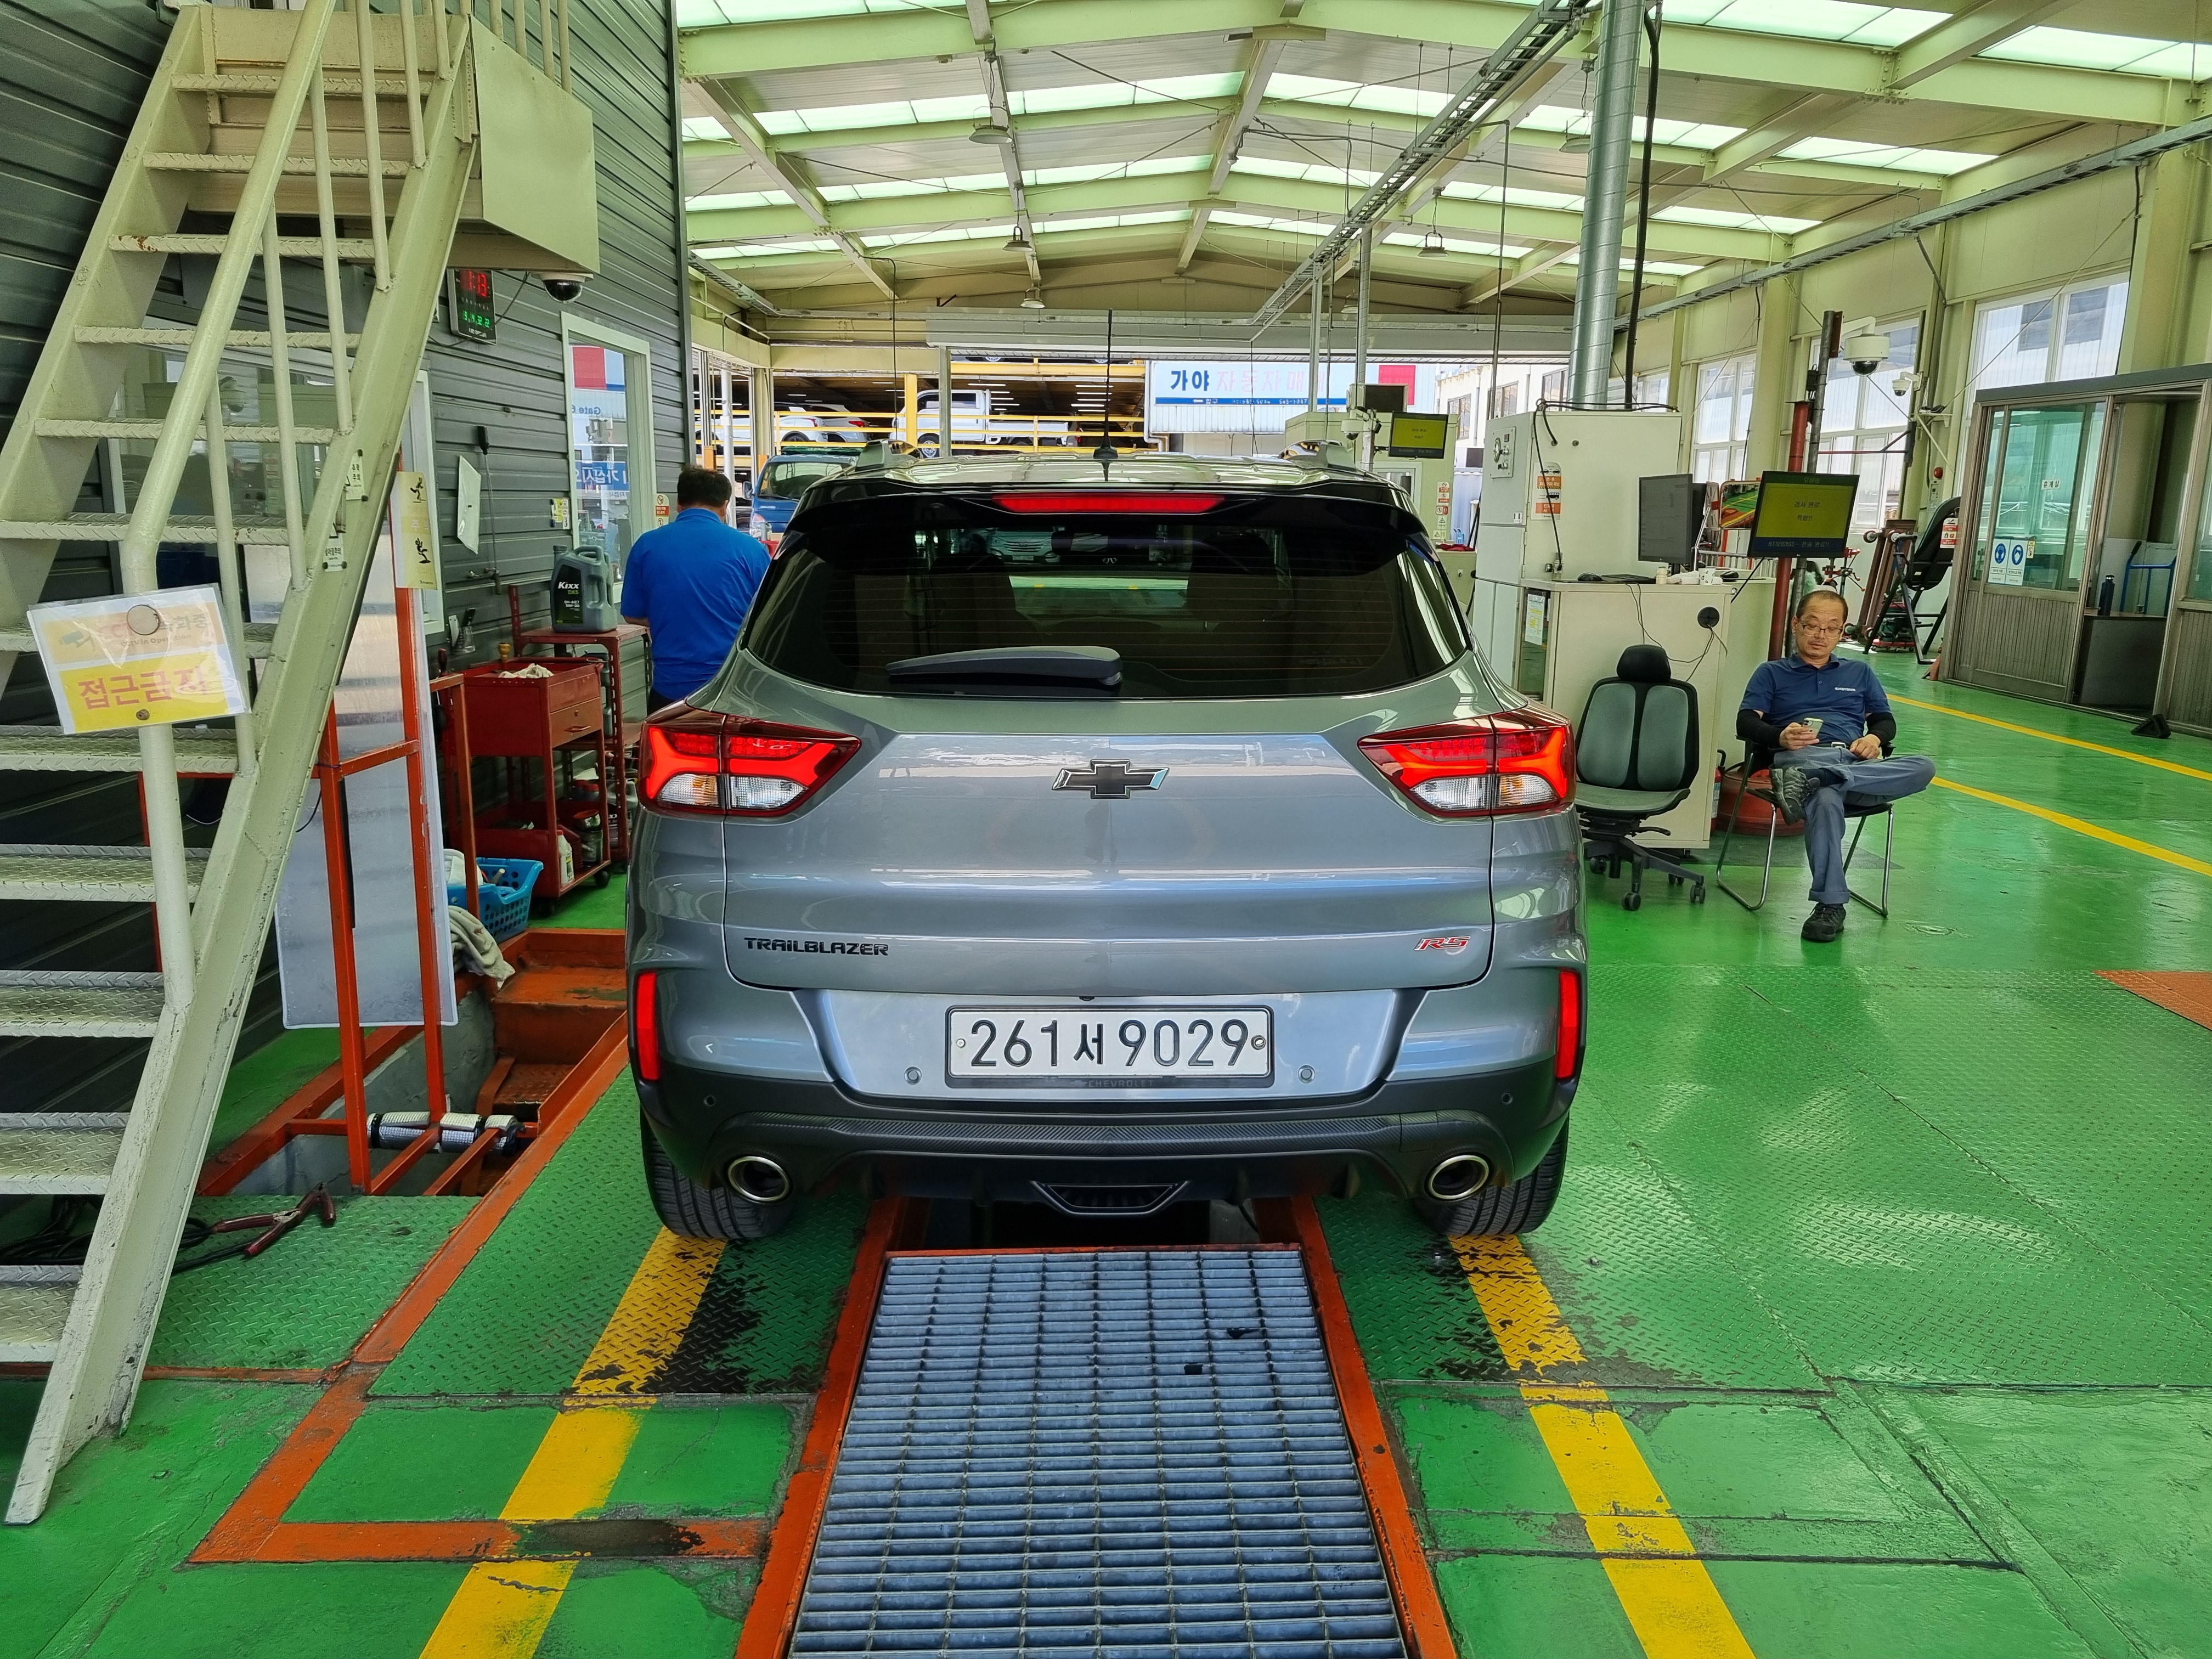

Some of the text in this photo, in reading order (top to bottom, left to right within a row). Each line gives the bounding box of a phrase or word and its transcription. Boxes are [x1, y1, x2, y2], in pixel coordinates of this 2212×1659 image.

[1170, 370, 1210, 391] 가야
[78, 665, 207, 709] 접근금지
[743, 937, 889, 956] TRAILBLAZER
[1414, 935, 1471, 951] RS
